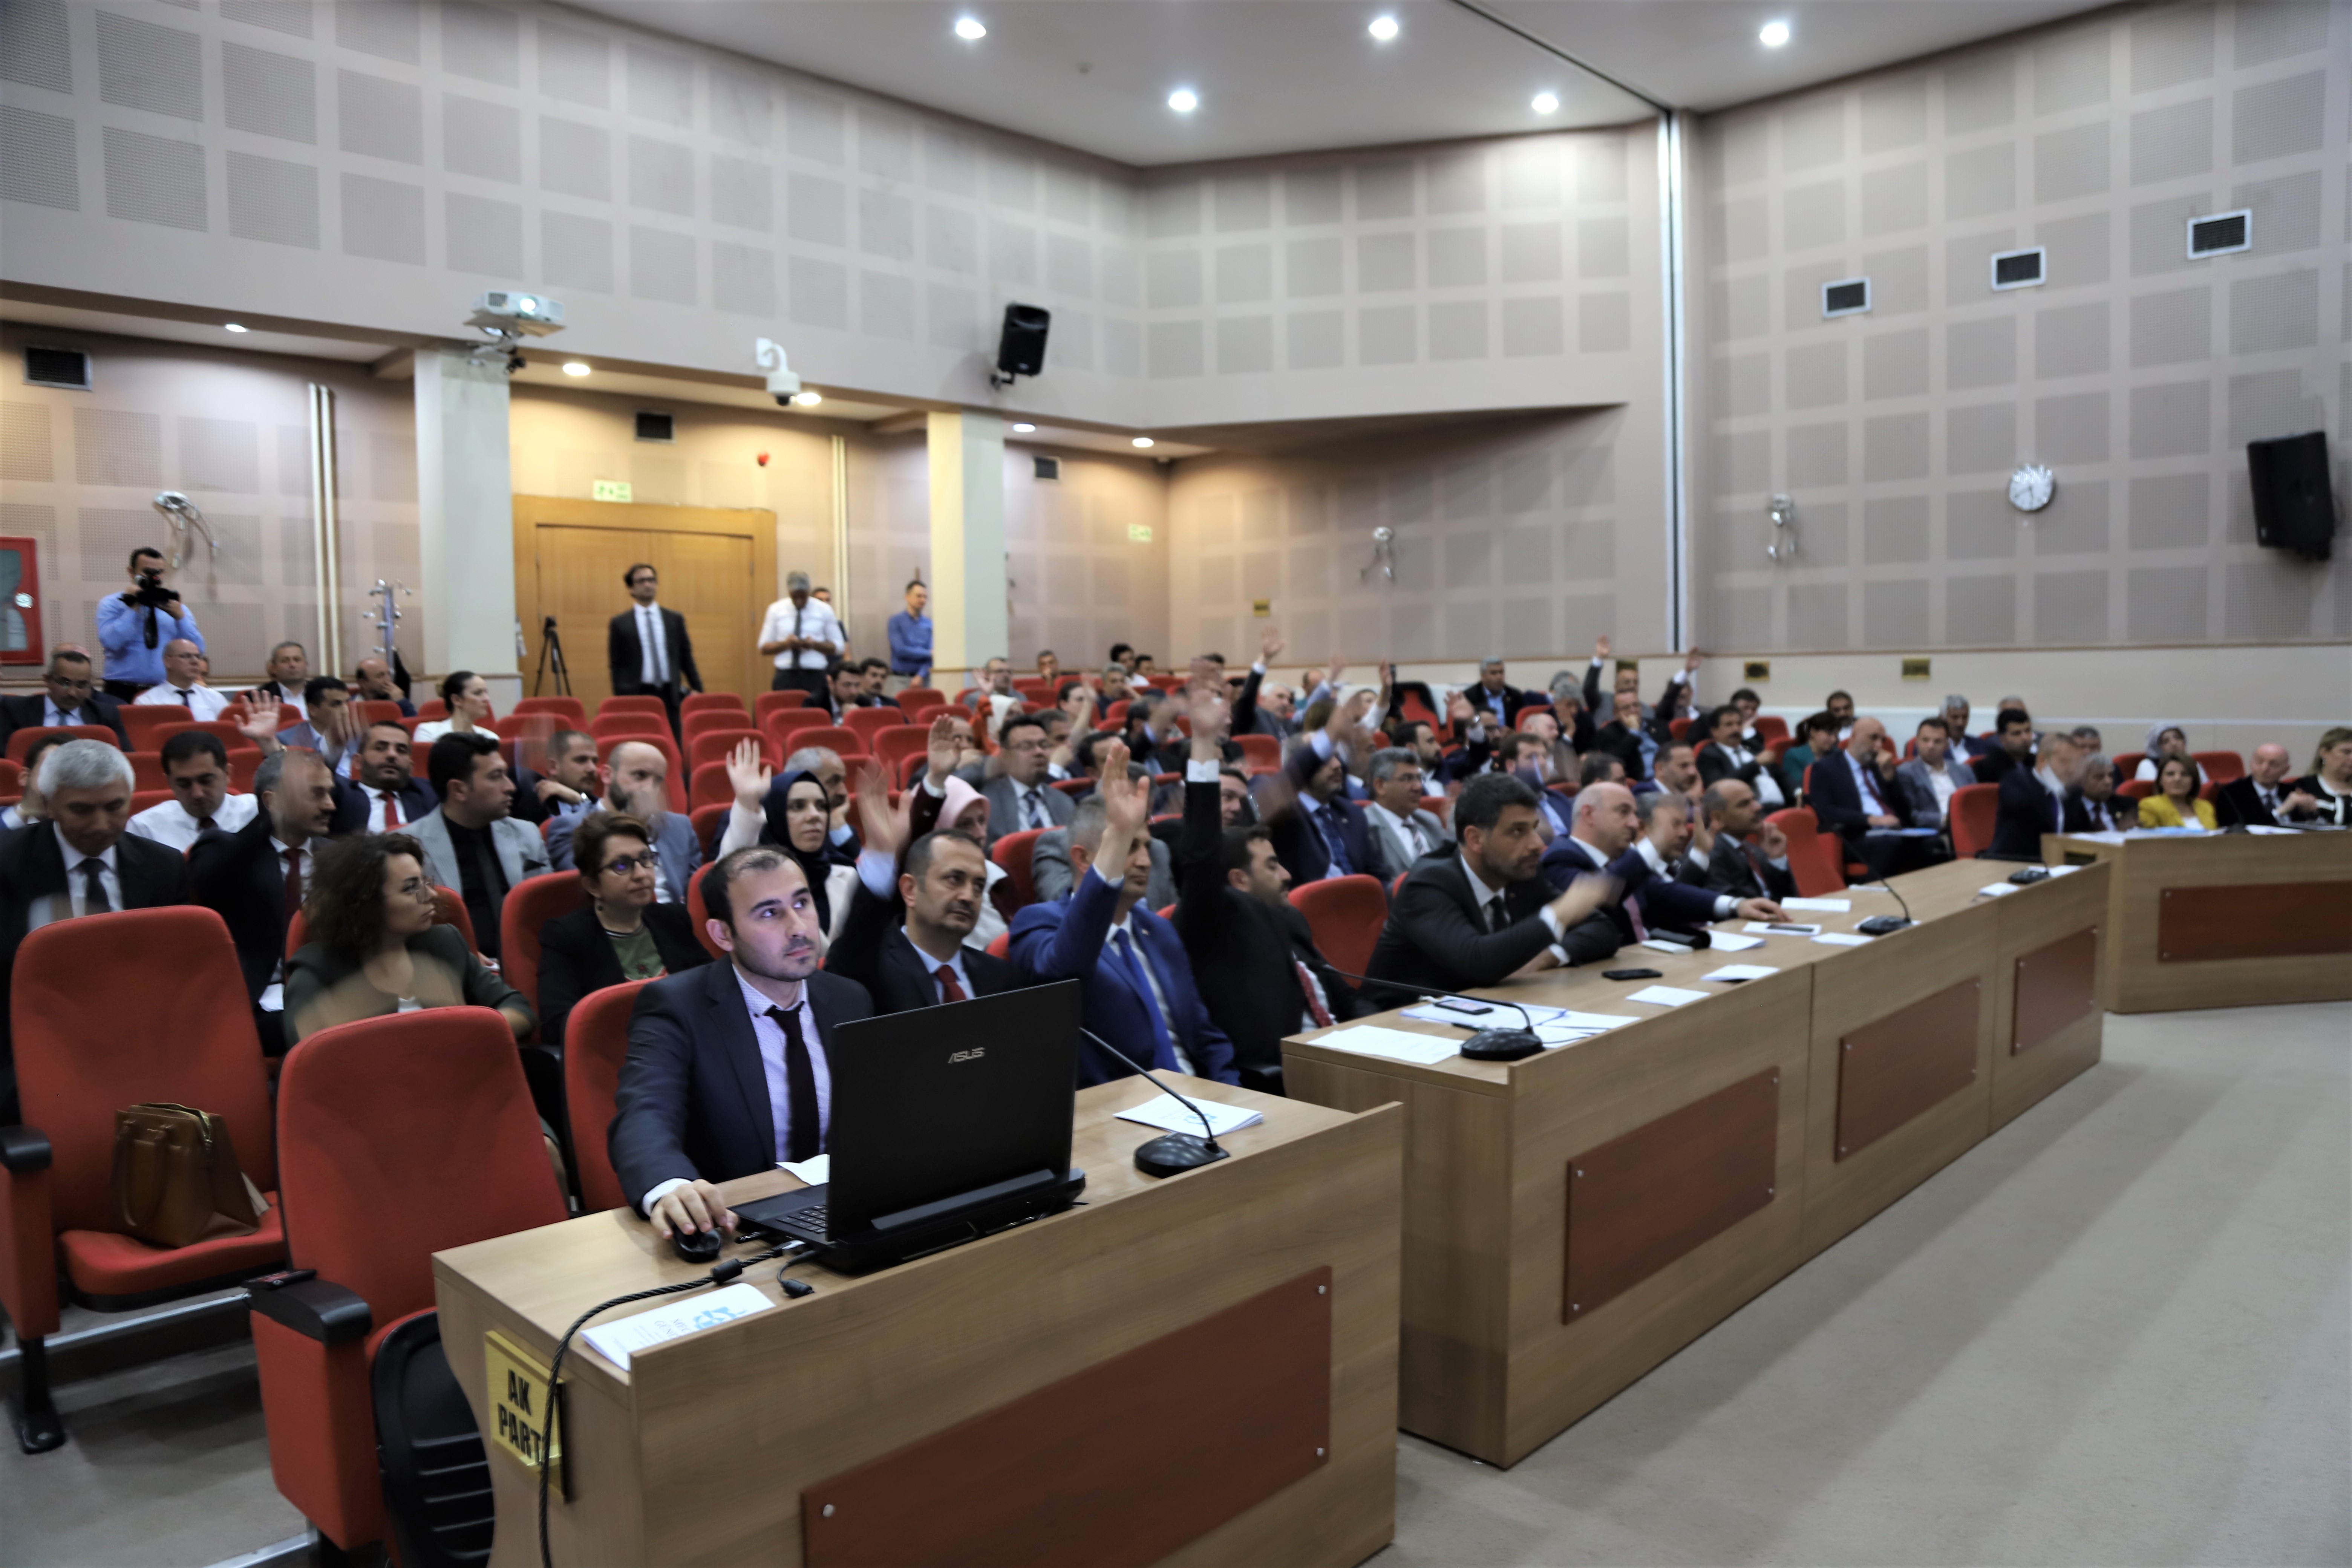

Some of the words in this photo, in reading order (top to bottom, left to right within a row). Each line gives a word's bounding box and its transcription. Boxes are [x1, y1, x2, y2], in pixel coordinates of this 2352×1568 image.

[948, 1047, 985, 1064] ASUS
[654, 1320, 678, 1338] GÜND
[671, 1318, 692, 1333] MEC
[508, 1368, 531, 1416] AK
[498, 1402, 545, 1465] PART
